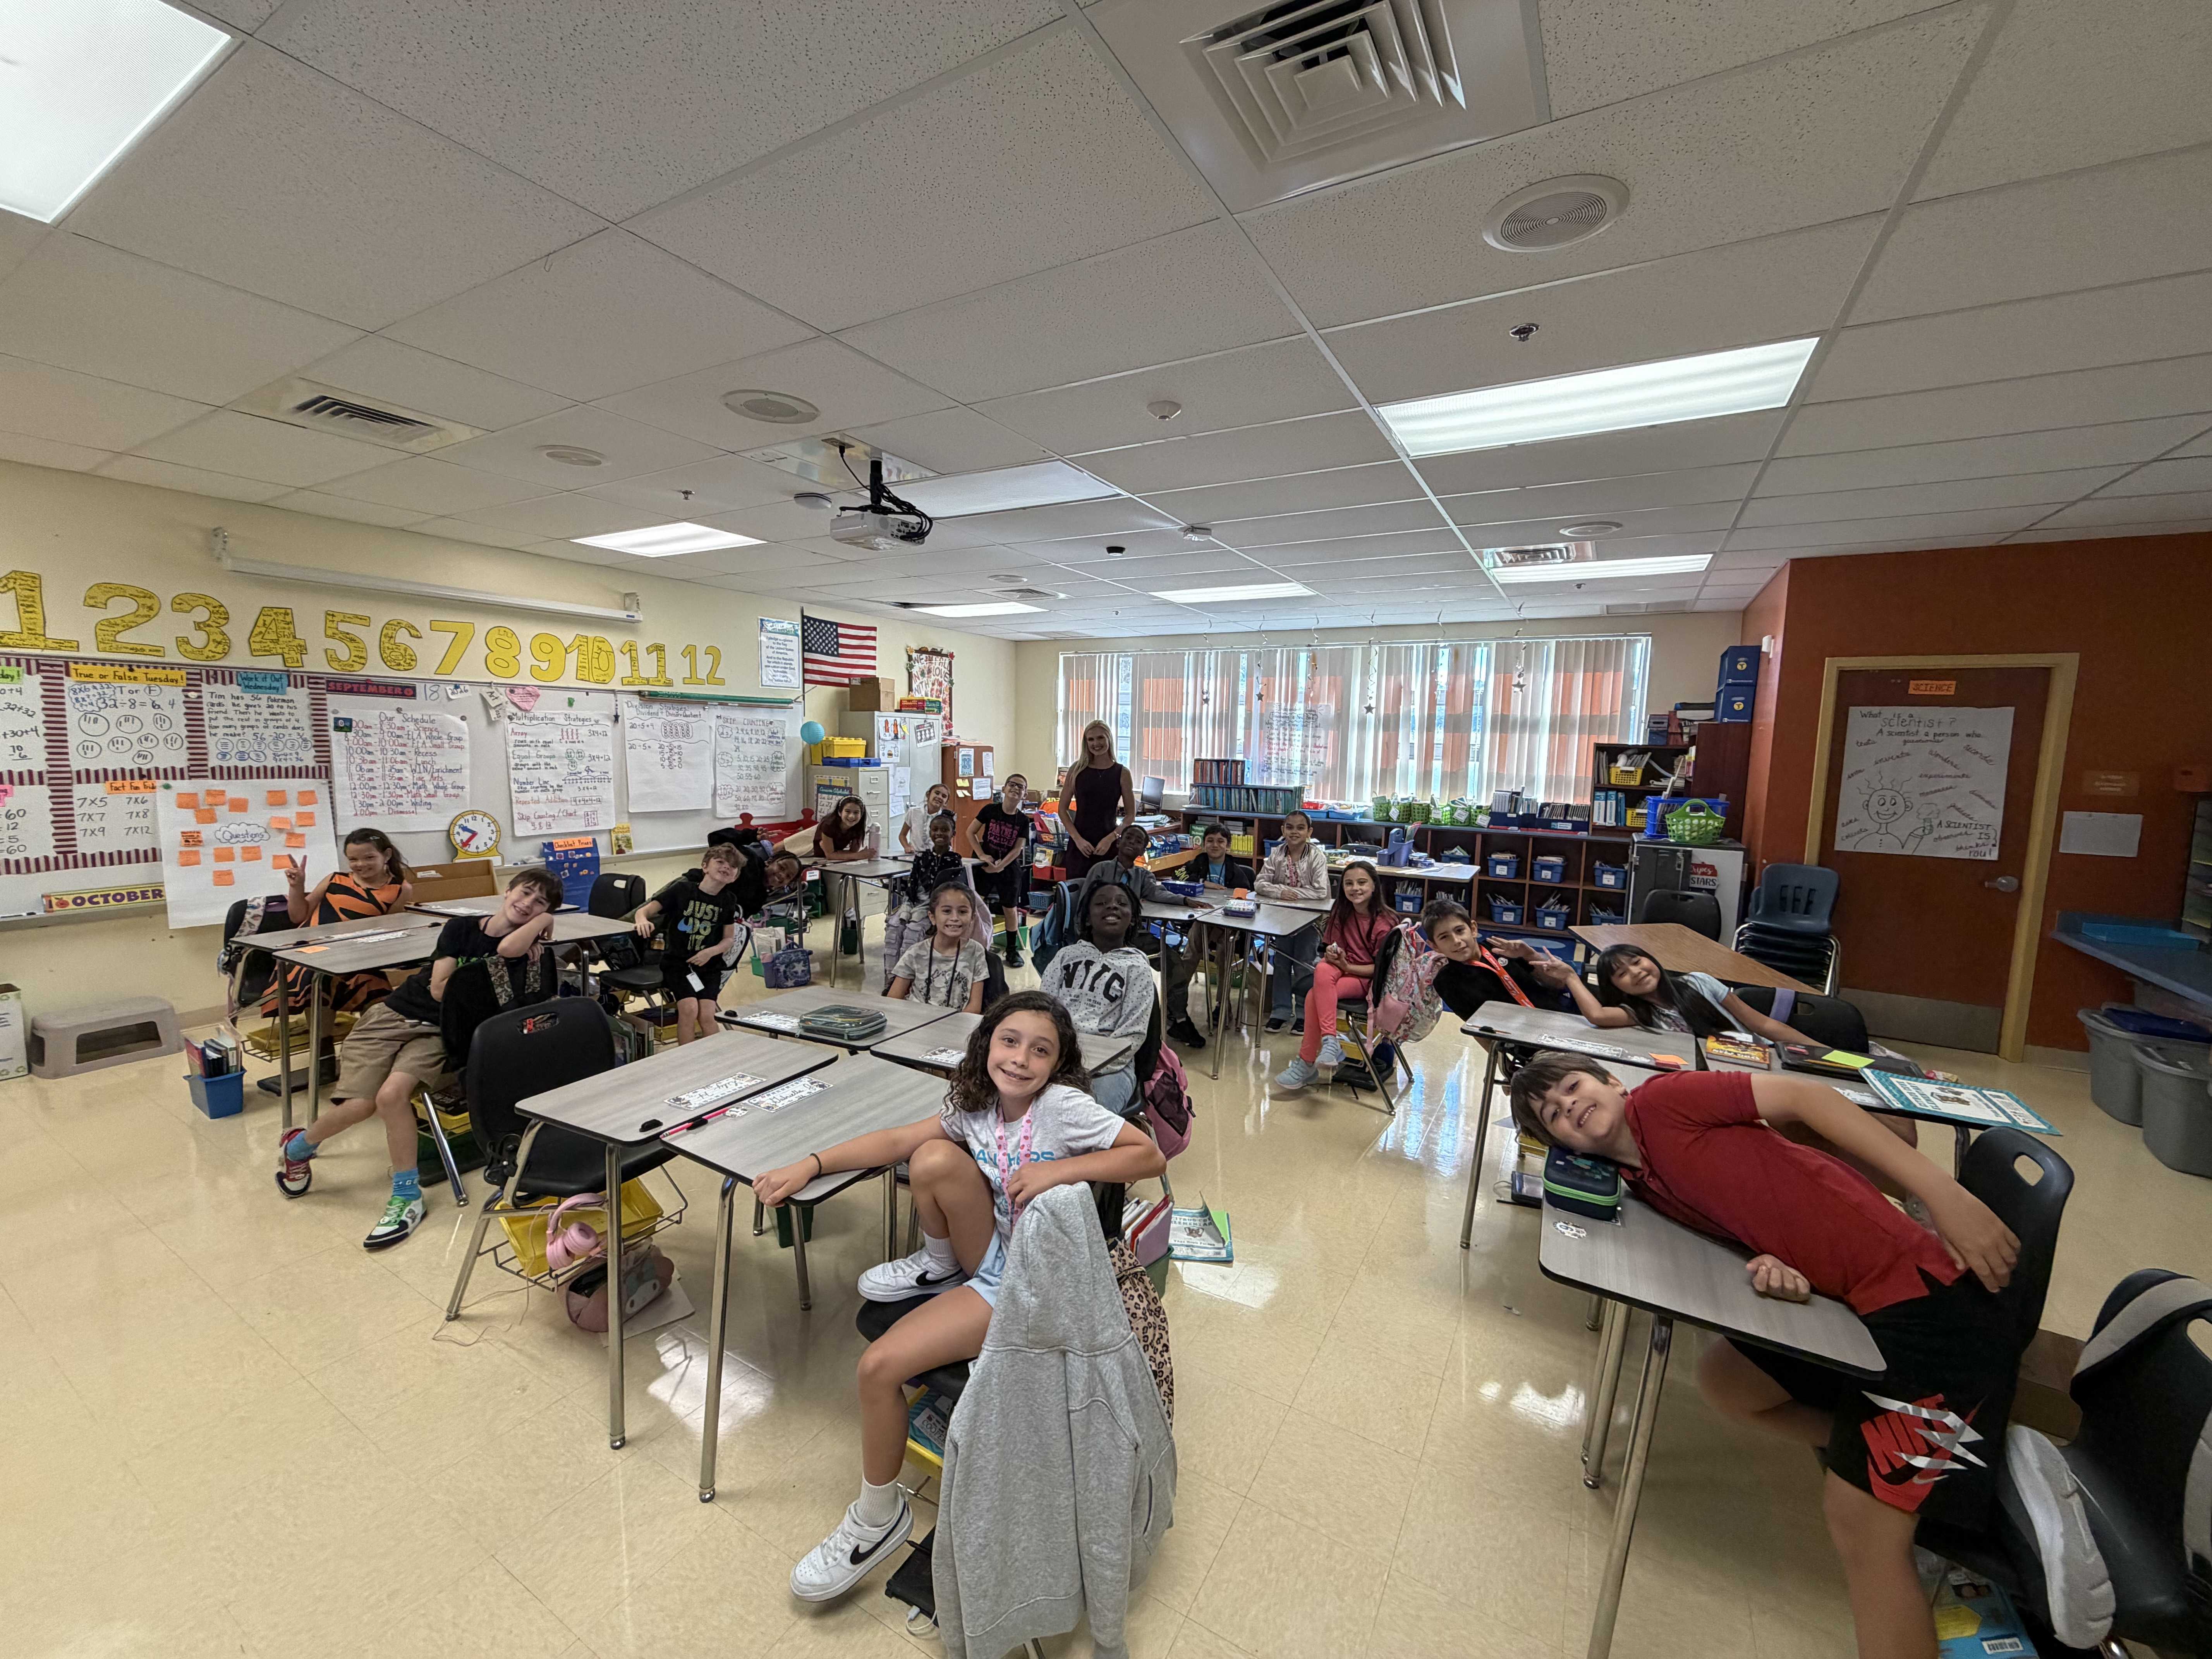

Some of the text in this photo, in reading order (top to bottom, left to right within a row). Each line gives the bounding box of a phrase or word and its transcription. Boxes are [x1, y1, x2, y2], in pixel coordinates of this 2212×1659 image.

[0, 570, 79, 652] 1
[84, 582, 165, 656] 2
[172, 593, 231, 661] 3
[250, 607, 308, 667] 4
[325, 610, 370, 672] 5
[380, 619, 422, 671] 6
[430, 620, 475, 675] 7
[485, 626, 521, 678] 8
[530, 633, 566, 682] 9
[566, 634, 616, 684] 10
[620, 640, 673, 687] 11
[681, 644, 725, 685] 12
[72, 669, 94, 678] True
[114, 671, 138, 681] False
[143, 673, 184, 684] Tuesday!
[240, 673, 259, 682] Work
[117, 686, 126, 694] T
[148, 686, 156, 694] F
[244, 683, 283, 692] Wednesday!
[328, 682, 401, 694] SEPTEMBER
[424, 684, 440, 701] 18
[448, 686, 469, 696] 2026
[1913, 683, 1953, 693] SCIENCE
[486, 691, 498, 701] Art
[626, 700, 653, 709] Division
[379, 712, 436, 724] Our Schedule
[512, 713, 591, 724] Multiplication Strategies
[1881, 718, 1942, 728] scientist
[414, 723, 439, 732] Science
[511, 728, 527, 738] Array
[252, 733, 266, 741] 56
[407, 730, 463, 742] ELA Whole Group
[412, 739, 426, 748] ELA
[448, 741, 464, 750] Group
[414, 748, 437, 756] Recess
[512, 750, 555, 762] Equal Groups
[416, 756, 436, 765] Lunch
[429, 773, 443, 781] Arts
[110, 783, 126, 791] Fact
[130, 783, 140, 791] Fun
[413, 780, 427, 789] Math
[451, 781, 465, 792] Group
[407, 789, 460, 799] Math Small Group
[515, 794, 568, 804] Repeated Addition
[411, 799, 431, 810] Writing
[518, 812, 530, 821] Skip
[534, 812, 555, 820] Counting
[1945, 821, 1992, 829] SCIENTIST
[222, 829, 265, 841] Questions
[555, 841, 575, 849] Checklist
[1691, 877, 1717, 886] STARS
[72, 889, 164, 907] OCTOBER
[683, 900, 719, 922] JUST
[686, 917, 711, 936] DO
[922, 1420, 945, 1441] COOPE
